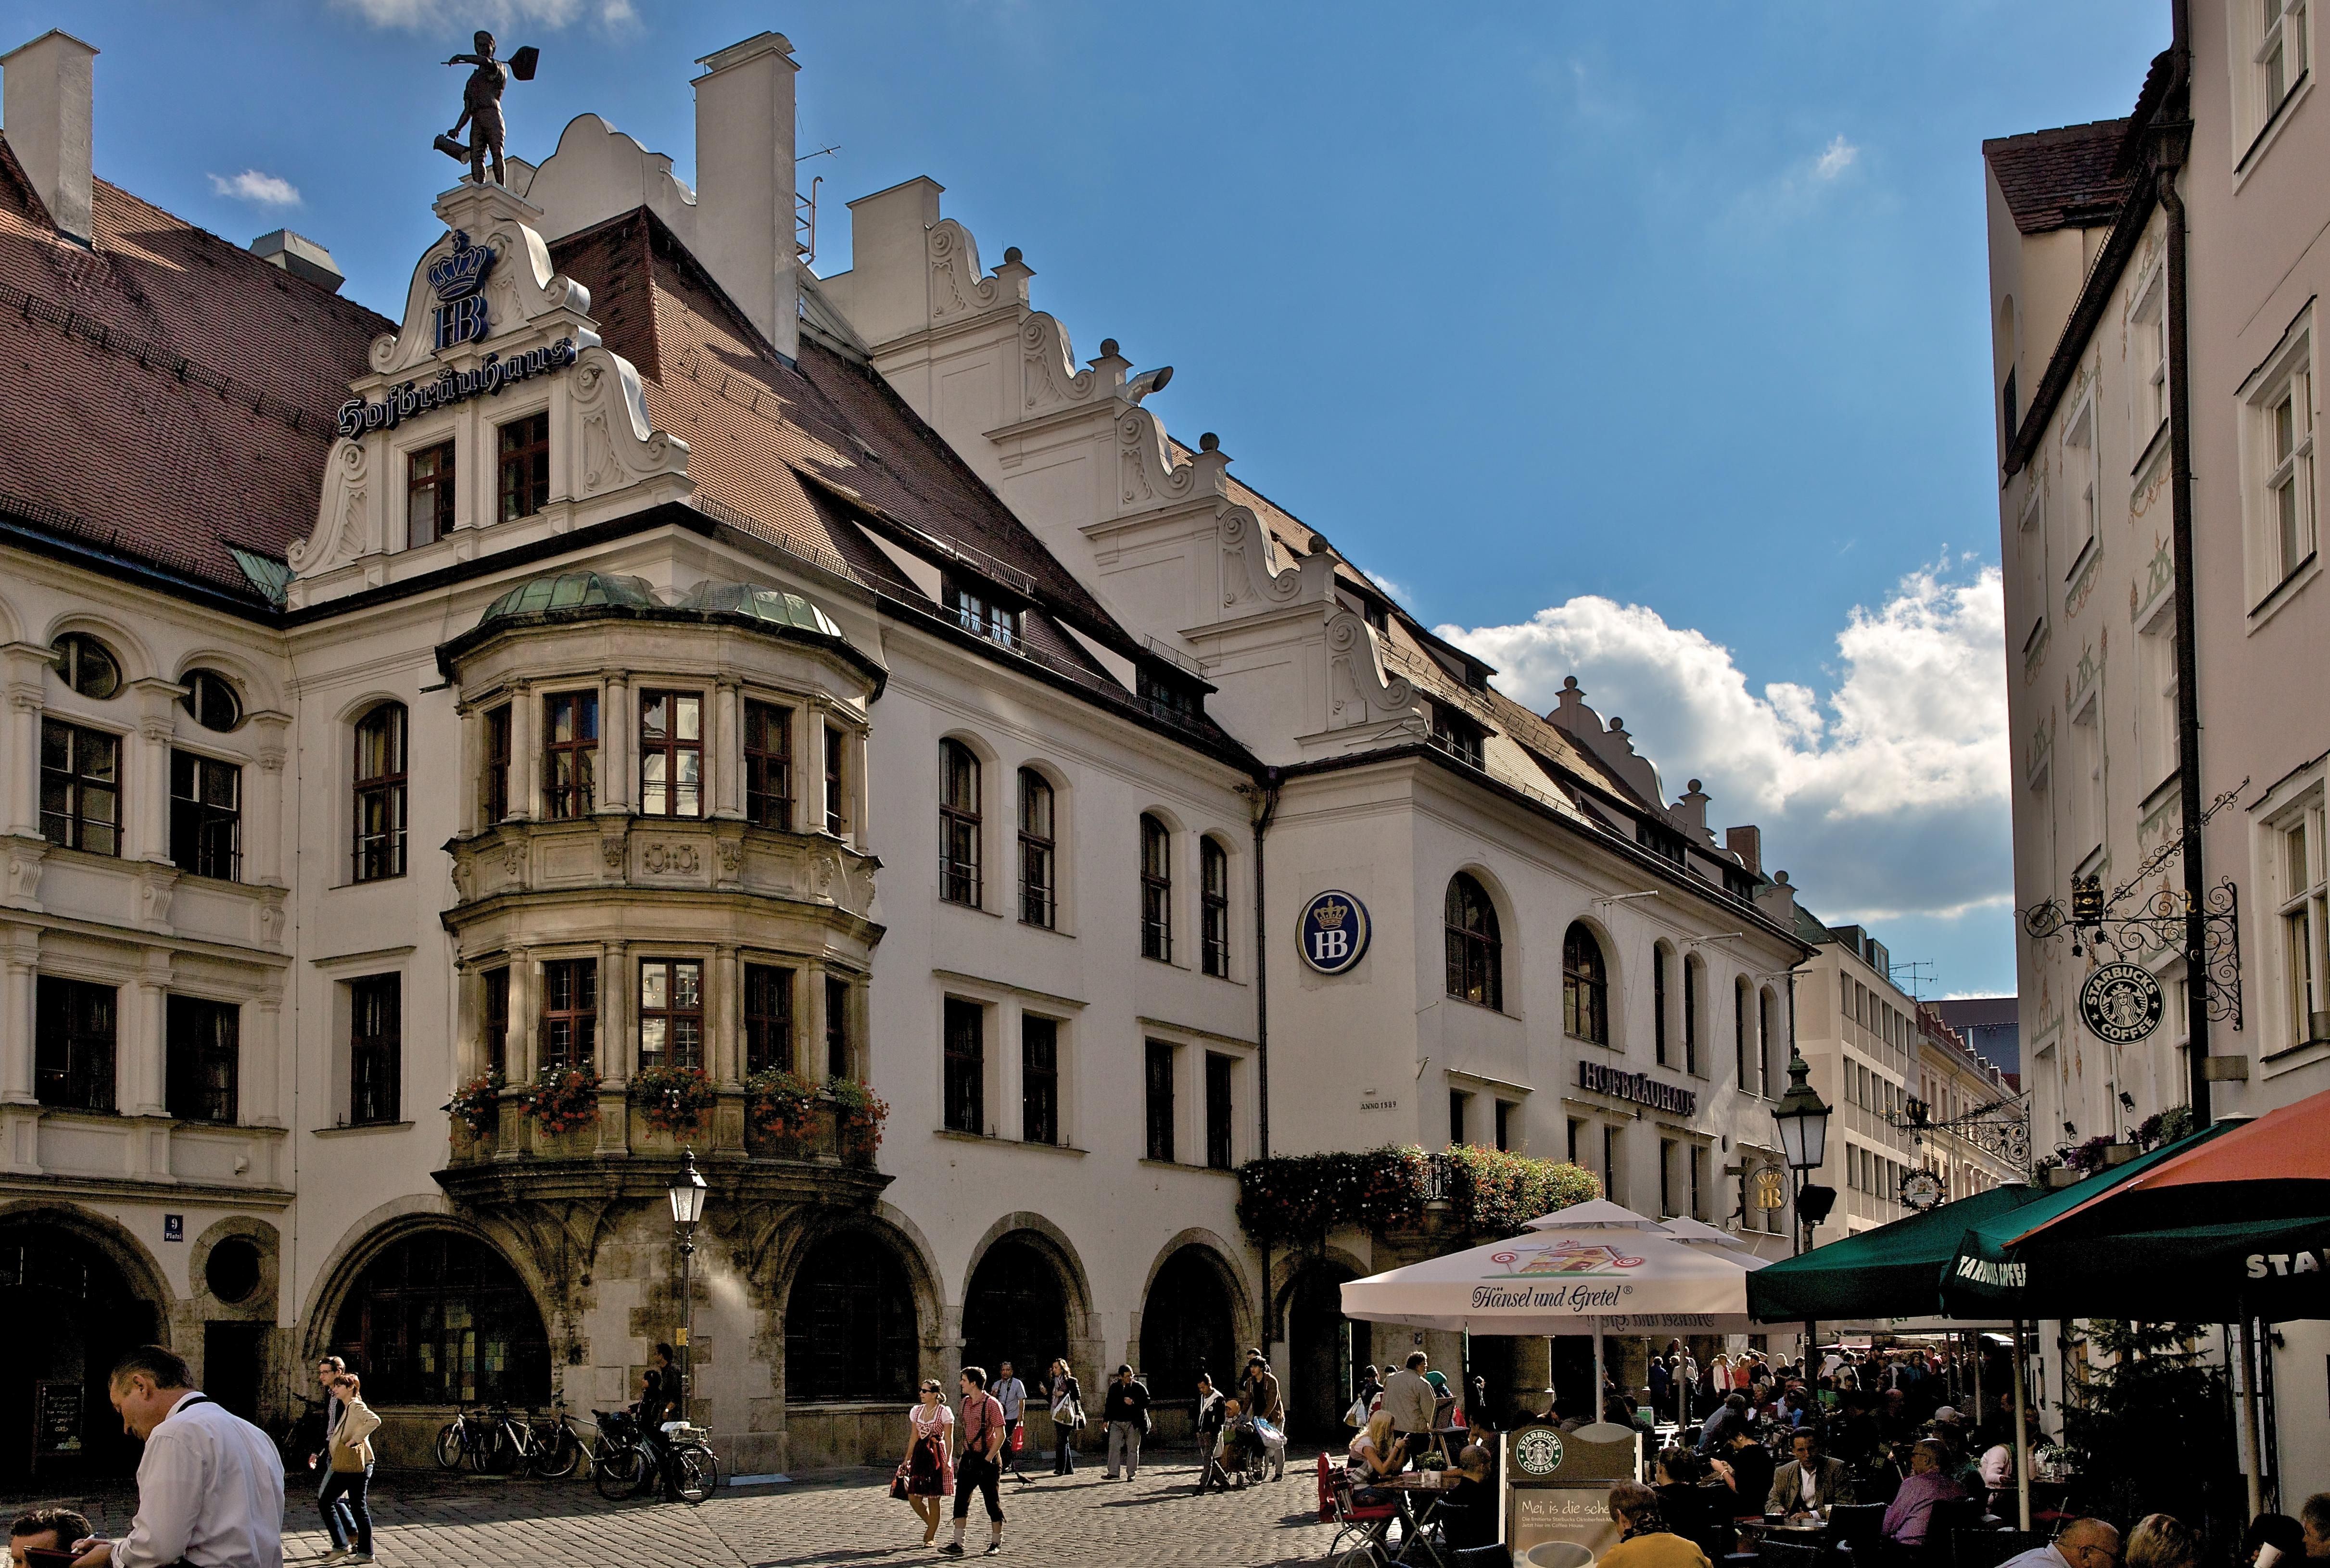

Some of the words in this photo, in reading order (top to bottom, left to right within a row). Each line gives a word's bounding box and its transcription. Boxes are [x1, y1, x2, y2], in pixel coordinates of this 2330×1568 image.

[431, 294, 485, 355] HB
[338, 338, 576, 440] Hofbräuhaus
[1314, 929, 1348, 960] HB
[2087, 967, 2157, 1005] STARBUCKS
[2101, 1016, 2156, 1040] COFFEE
[1580, 1061, 1696, 1117] HOFBRÄUHAUS
[1380, 1100, 1396, 1109] 1589
[1757, 1188, 1782, 1208] HB
[172, 1218, 177, 1229] 9
[1472, 1286, 1533, 1308] Hänsel
[1534, 1286, 1566, 1307] und
[1519, 1432, 1560, 1451] STARBUCKS
[1523, 1461, 1555, 1472] COFFEE
[1522, 1500, 1545, 1515] Mei,
[1549, 1501, 1558, 1514] is
[1562, 1500, 1580, 1514] die
